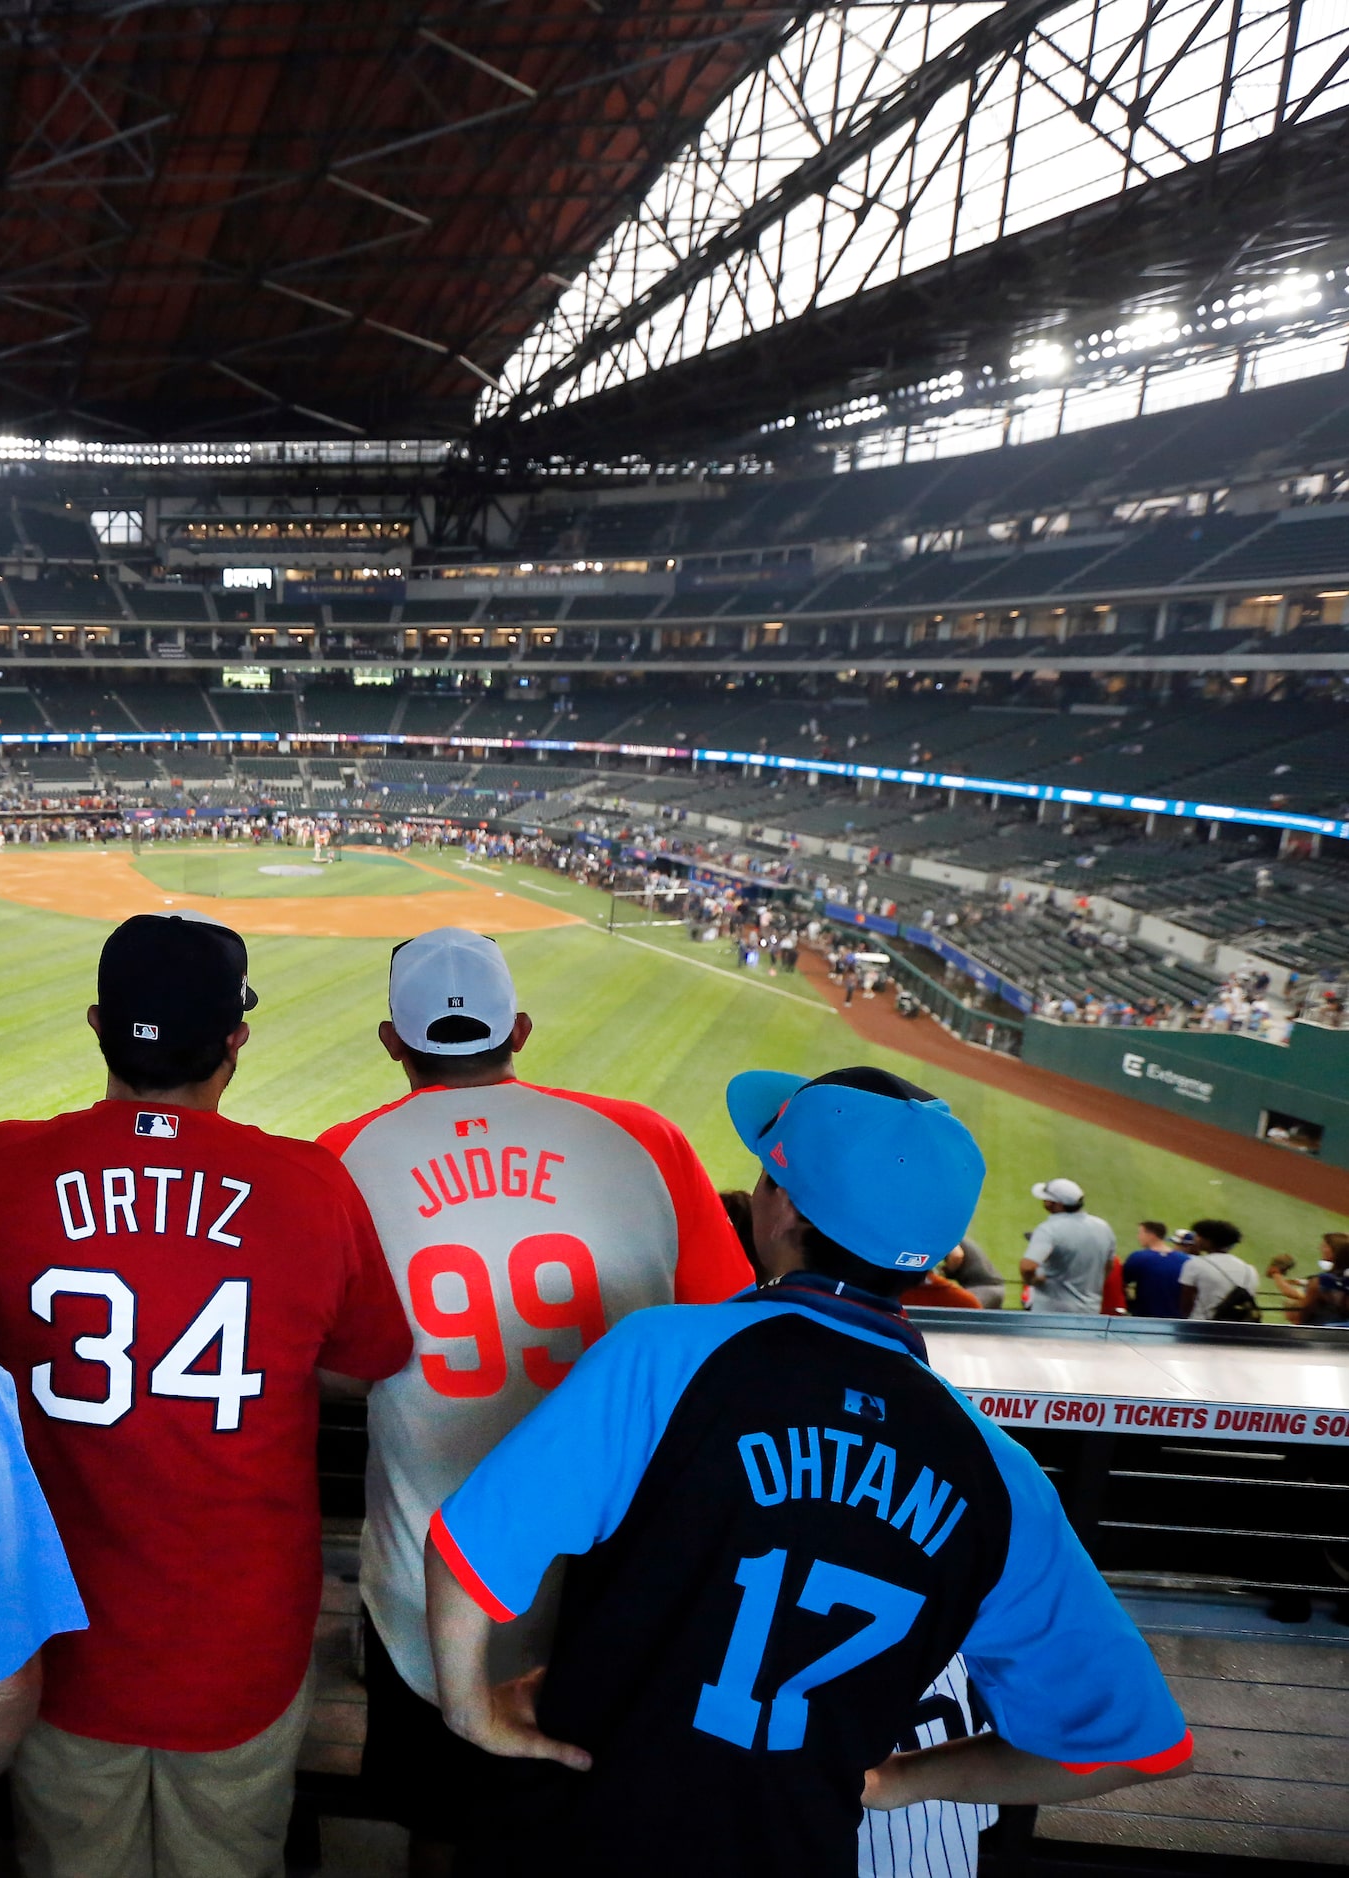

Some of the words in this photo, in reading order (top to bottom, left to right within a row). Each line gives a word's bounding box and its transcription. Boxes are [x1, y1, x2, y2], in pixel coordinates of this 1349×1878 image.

[55, 1167, 252, 1248] ORTIZ
[410, 1146, 566, 1219] JUDGE
[29, 1265, 266, 1433] 34
[407, 1232, 607, 1400] 99
[979, 1396, 1039, 1419] ONLY
[1044, 1400, 1106, 1427] (SRO)
[1114, 1404, 1209, 1430] TICKETS
[1214, 1409, 1307, 1435] DURING
[737, 1426, 968, 1558] OHTANI
[692, 1548, 927, 1752] 17
